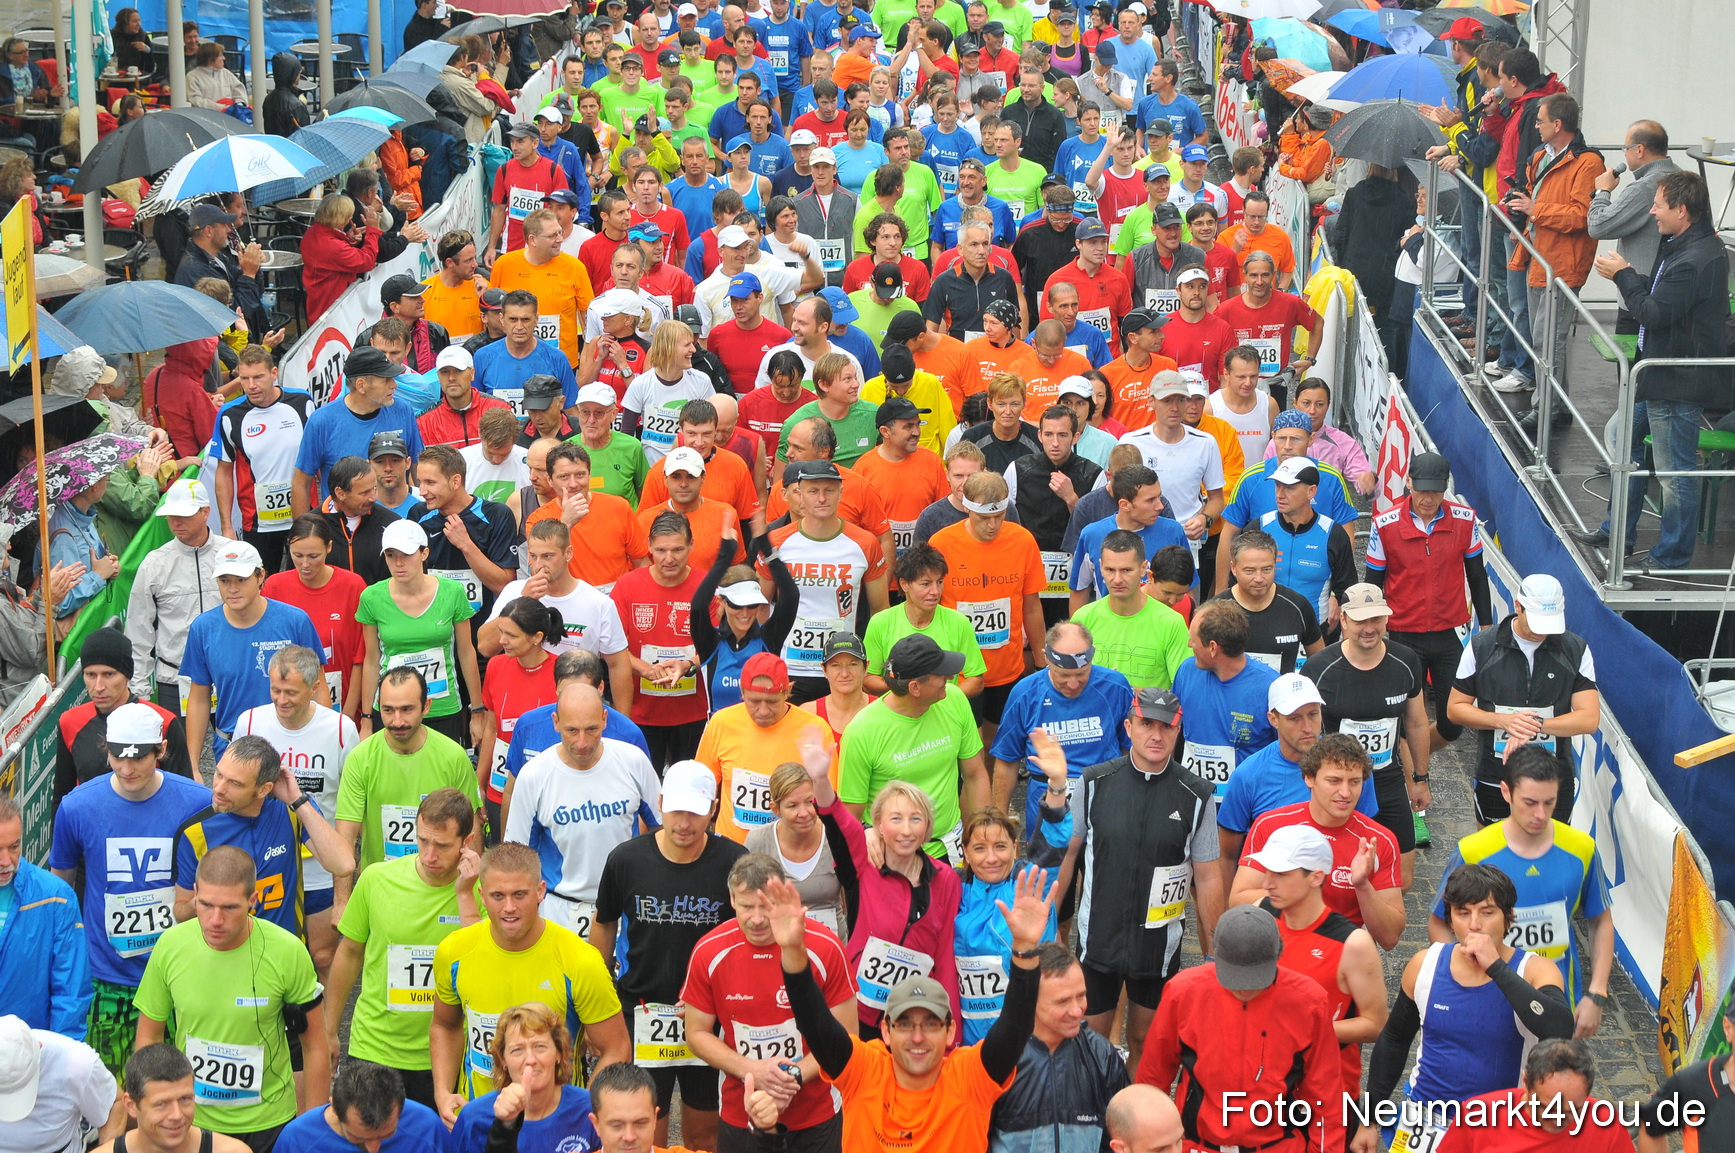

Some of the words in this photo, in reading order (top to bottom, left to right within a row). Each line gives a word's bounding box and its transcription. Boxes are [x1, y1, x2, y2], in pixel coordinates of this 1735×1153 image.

[513, 196, 541, 210] 2666
[1149, 298, 1180, 312] 2250
[247, 426, 261, 435] tkn
[785, 563, 852, 580] MERZ
[793, 576, 837, 588] eisen
[1041, 716, 1101, 736] HUBER
[1186, 757, 1229, 782] 2153
[552, 800, 629, 826] Gothaer
[1160, 879, 1187, 905] 576
[672, 895, 724, 912] HiRo
[112, 905, 173, 935] 2213
[968, 1001, 997, 1011] Andrea
[659, 1048, 686, 1058] Klaus
[193, 1055, 255, 1089] 2209
[201, 1088, 238, 1100] Jochen
